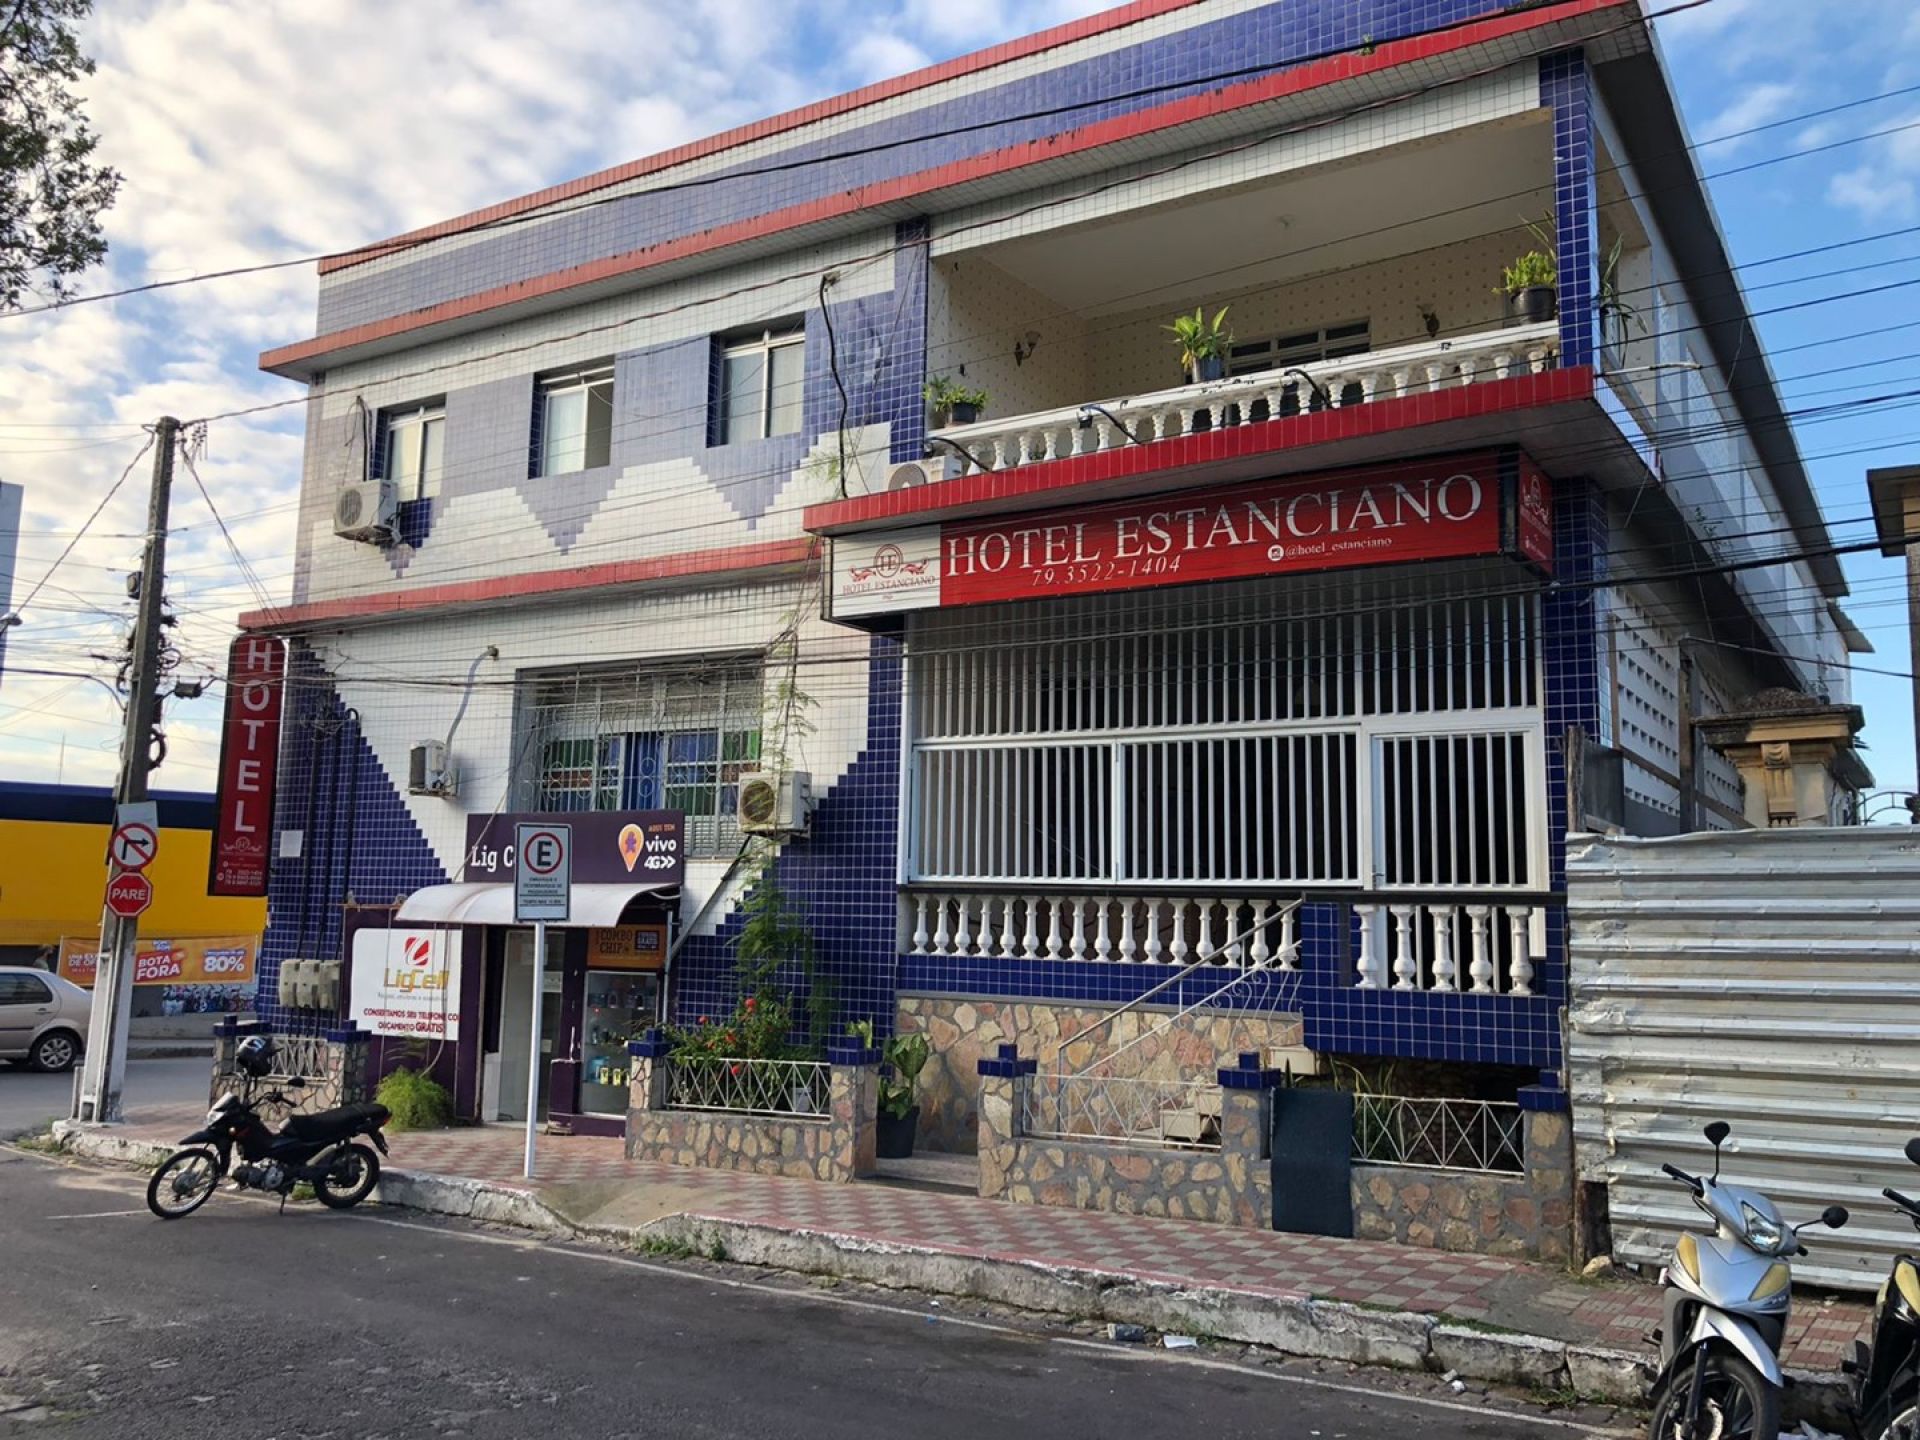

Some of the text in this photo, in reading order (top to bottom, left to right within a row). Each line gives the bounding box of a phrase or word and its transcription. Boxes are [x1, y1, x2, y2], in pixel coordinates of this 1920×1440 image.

[946, 523, 1101, 577] HOTEL
[1113, 474, 1483, 560] ESTANCIANO
[1285, 537, 1392, 559] @hotel_estanciano
[1032, 554, 1181, 586] 79.3522-1404
[235, 639, 272, 832] HOTEL
[645, 833, 677, 852] vivo
[470, 845, 515, 872] Lig C
[537, 840, 552, 867] E
[111, 888, 145, 900] PARE
[138, 955, 170, 968] BOTA
[204, 955, 245, 972] 80%
[136, 963, 181, 981] FORA
[447, 1012, 460, 1022] CO
